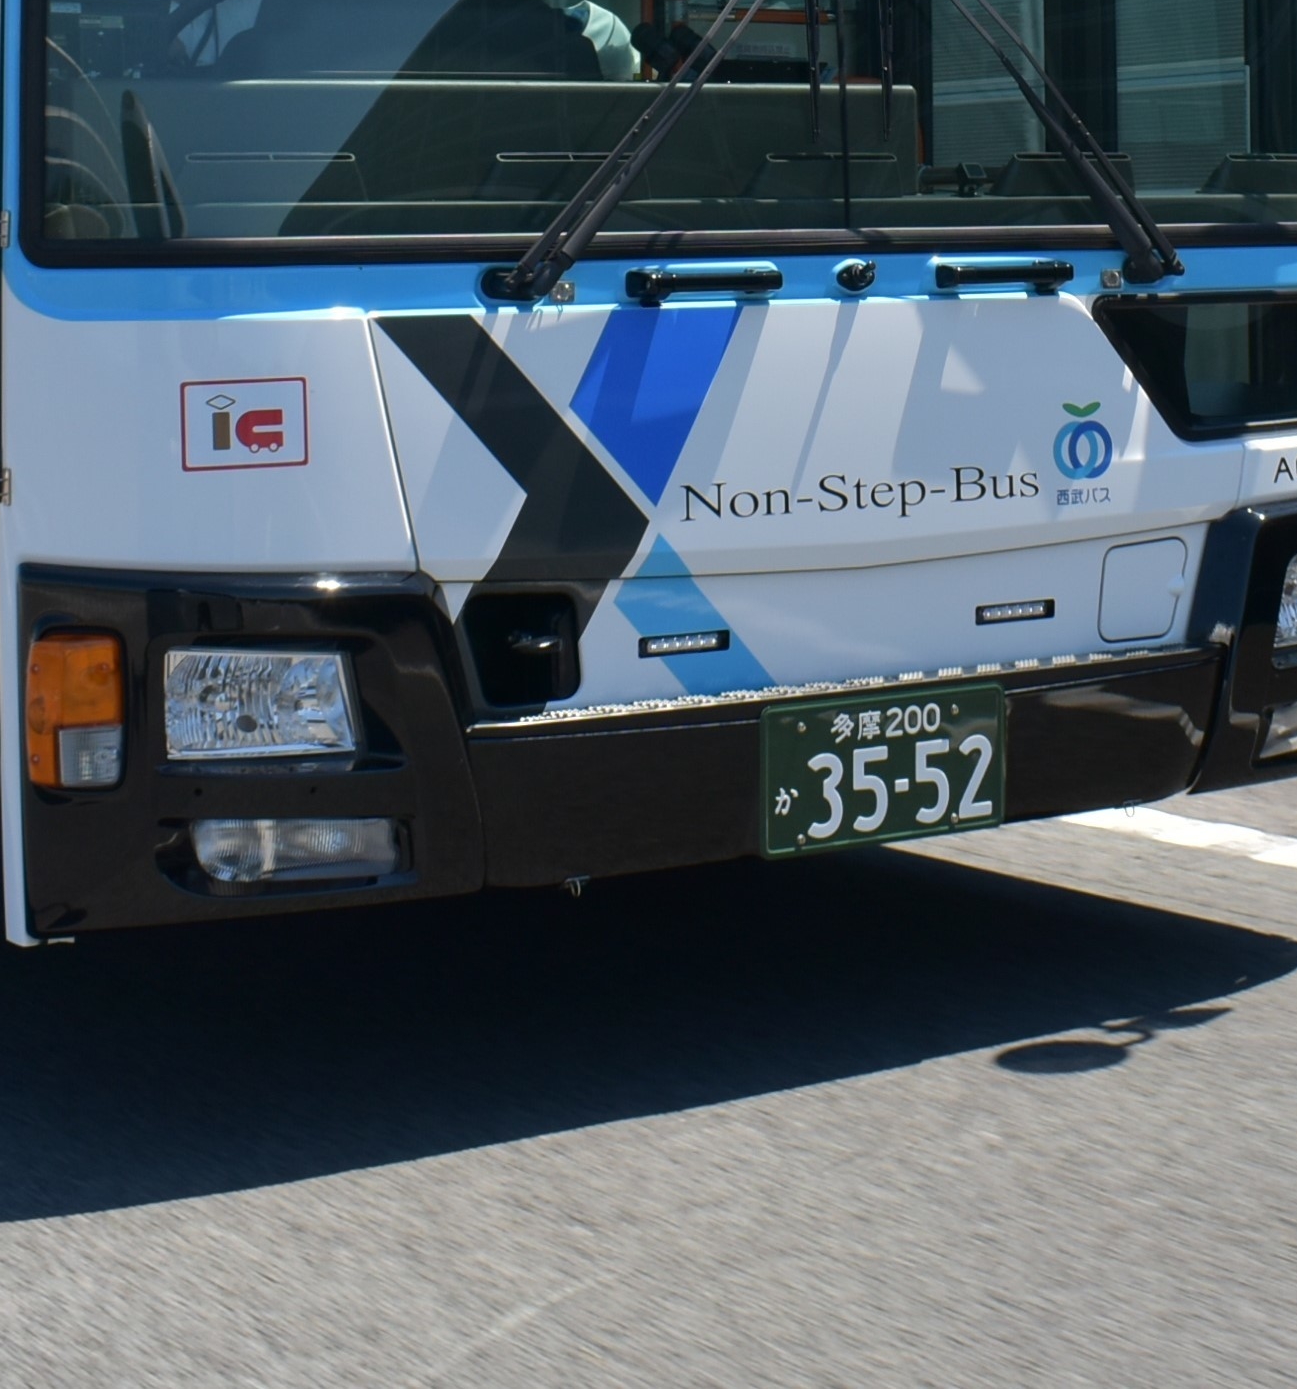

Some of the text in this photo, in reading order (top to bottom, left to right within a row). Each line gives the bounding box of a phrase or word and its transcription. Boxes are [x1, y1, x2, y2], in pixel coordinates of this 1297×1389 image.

[679, 465, 1041, 523] Non-Step-Bus
[1056, 486, 1112, 506] 西武バス
[774, 733, 994, 840] か 35-52
